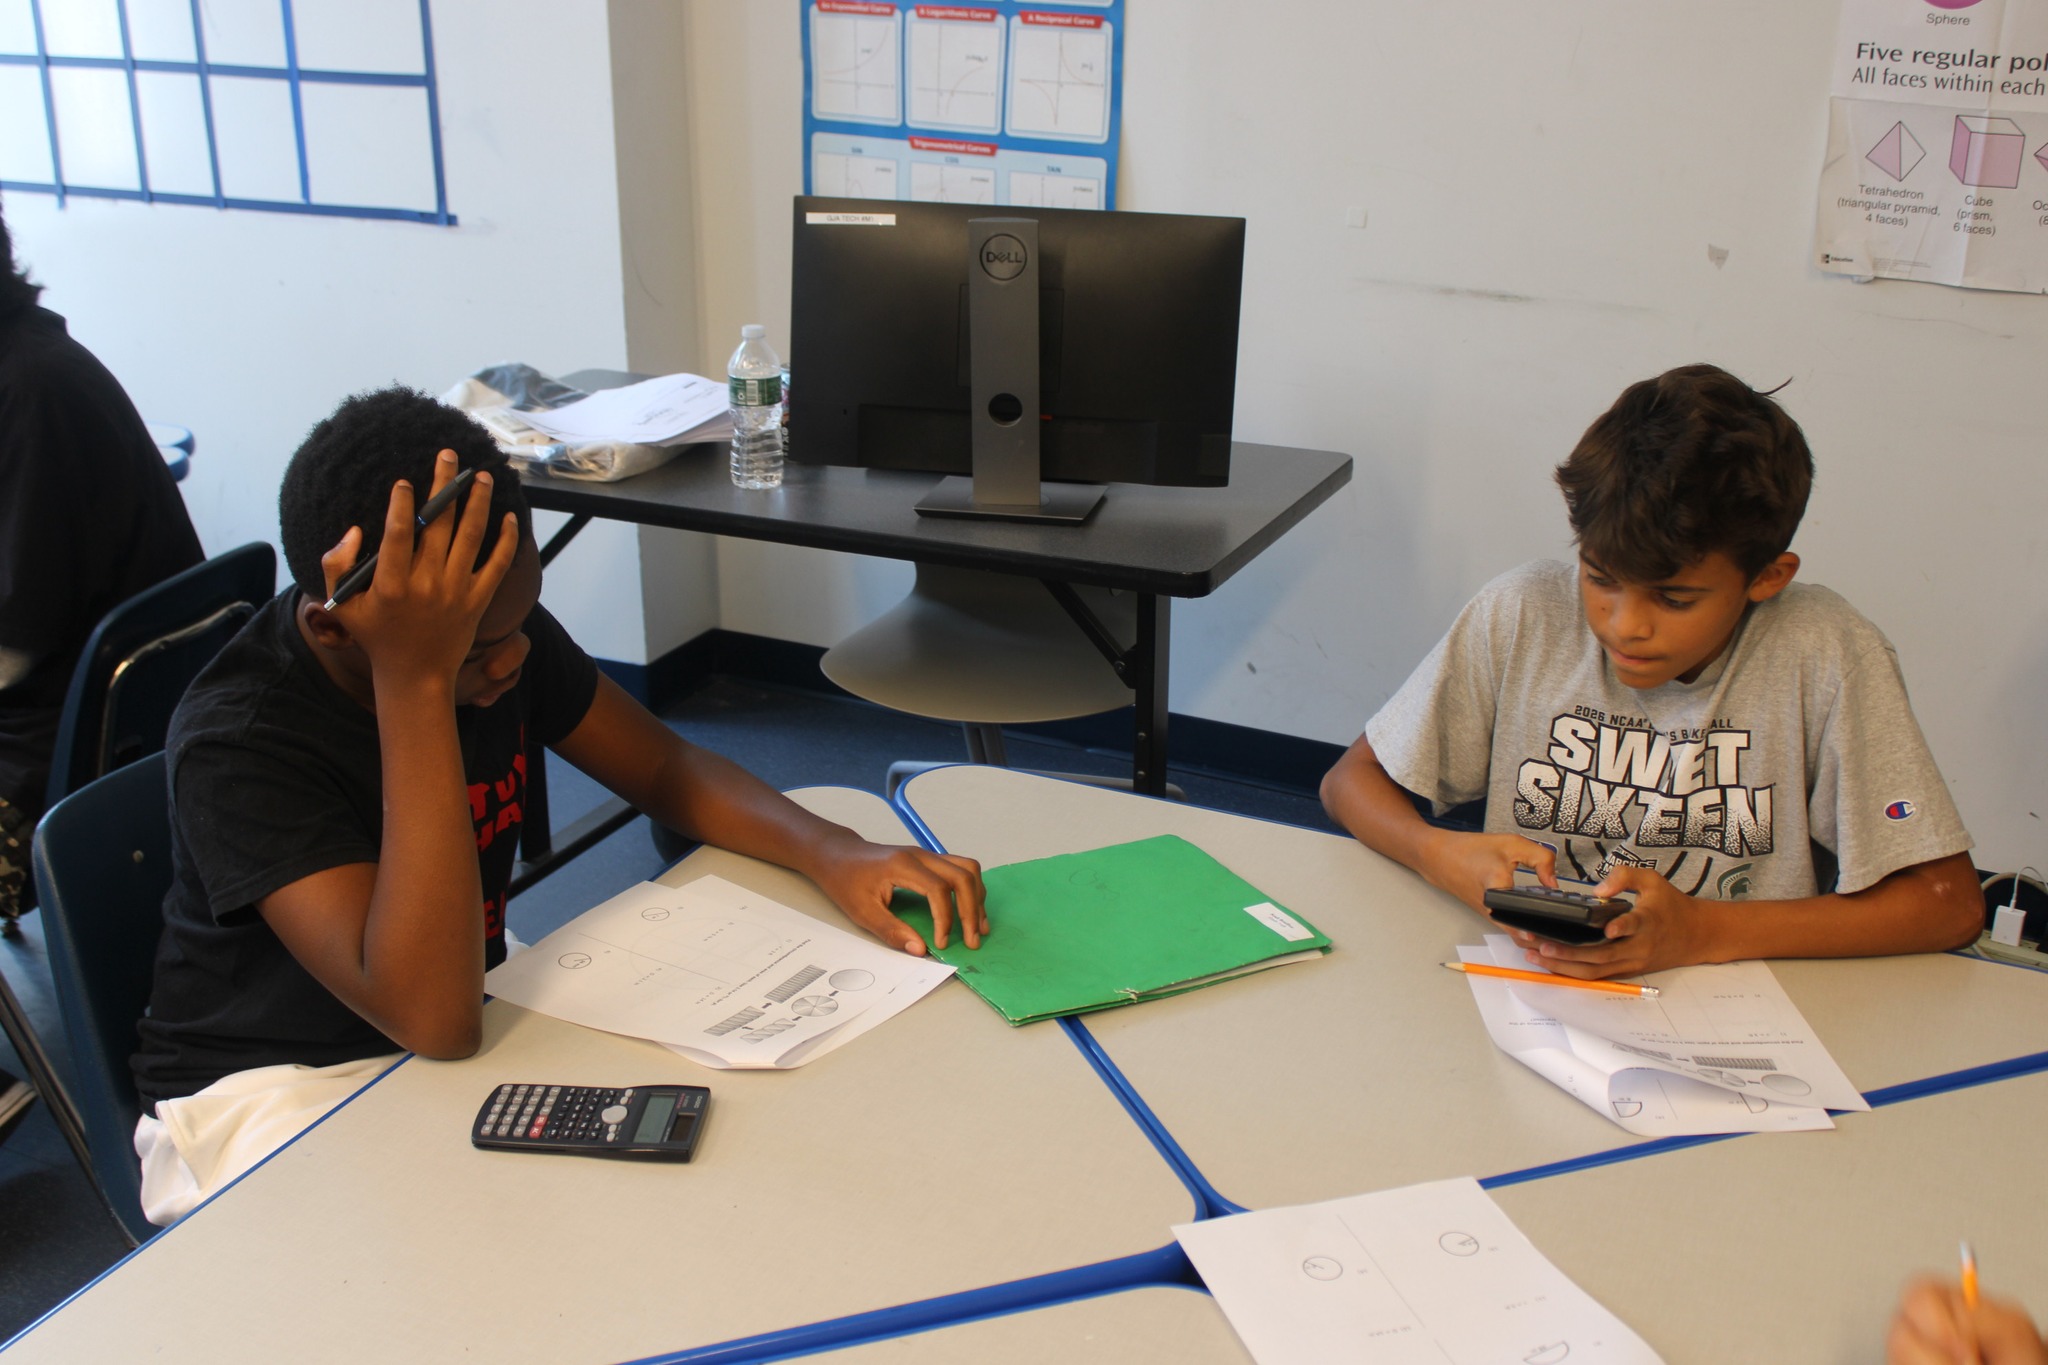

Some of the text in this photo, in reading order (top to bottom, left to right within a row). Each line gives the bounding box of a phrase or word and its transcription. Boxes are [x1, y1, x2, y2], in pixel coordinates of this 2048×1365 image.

[871, 6, 891, 14] Curve
[926, 8, 969, 19] Logarithmic
[970, 11, 992, 19] Curve
[1035, 14, 1072, 25] Reciprocal
[1074, 17, 1095, 26] Curve
[1926, 13, 1971, 27] Sphere
[1856, 41, 1903, 62] Five
[1912, 49, 2001, 71] regular
[1852, 66, 2045, 96] All faces within each
[967, 144, 991, 153] Curves
[1047, 166, 1062, 174] TAN
[1858, 184, 1924, 199] Tetrahedron
[1837, 197, 1941, 217] (triangular pyramid,
[1964, 195, 1994, 207] Cube
[1865, 213, 1909, 228] 4 faces)
[1957, 209, 1993, 222] (prsm,
[1953, 222, 1996, 237] 6 faces)
[986, 251, 1022, 264] DELL
[1548, 712, 1752, 798] SWET
